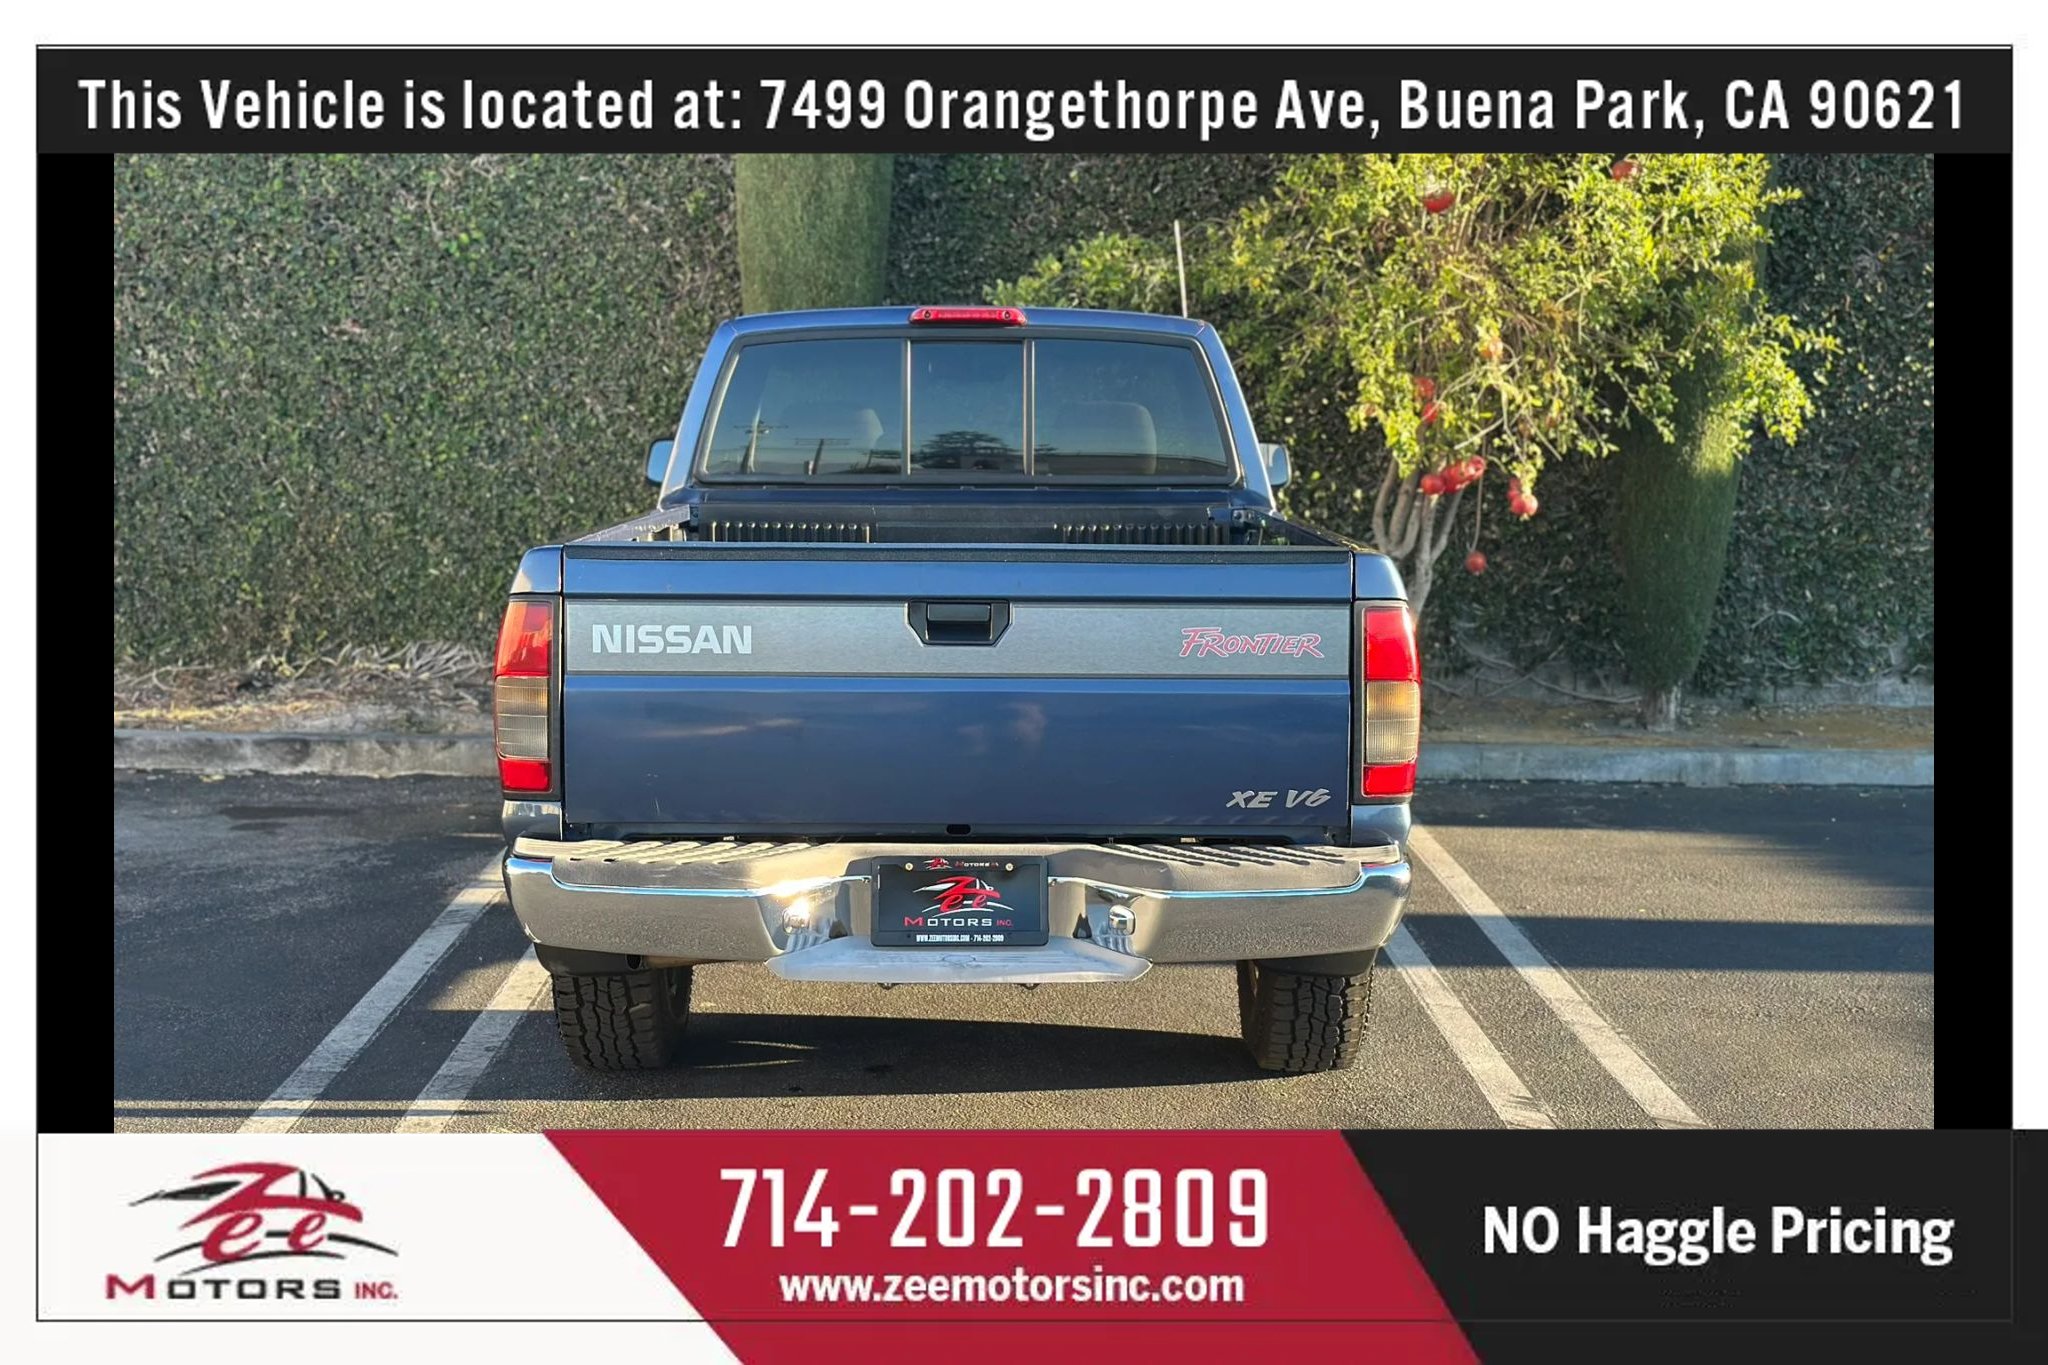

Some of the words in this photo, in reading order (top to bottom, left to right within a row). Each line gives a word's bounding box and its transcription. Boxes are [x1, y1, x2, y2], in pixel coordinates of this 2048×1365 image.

[592, 624, 752, 654] NISSAN
[1226, 790, 1278, 808] XE
[1285, 788, 1331, 808] V6
[916, 934, 970, 942] WWW.ZEE.COM
